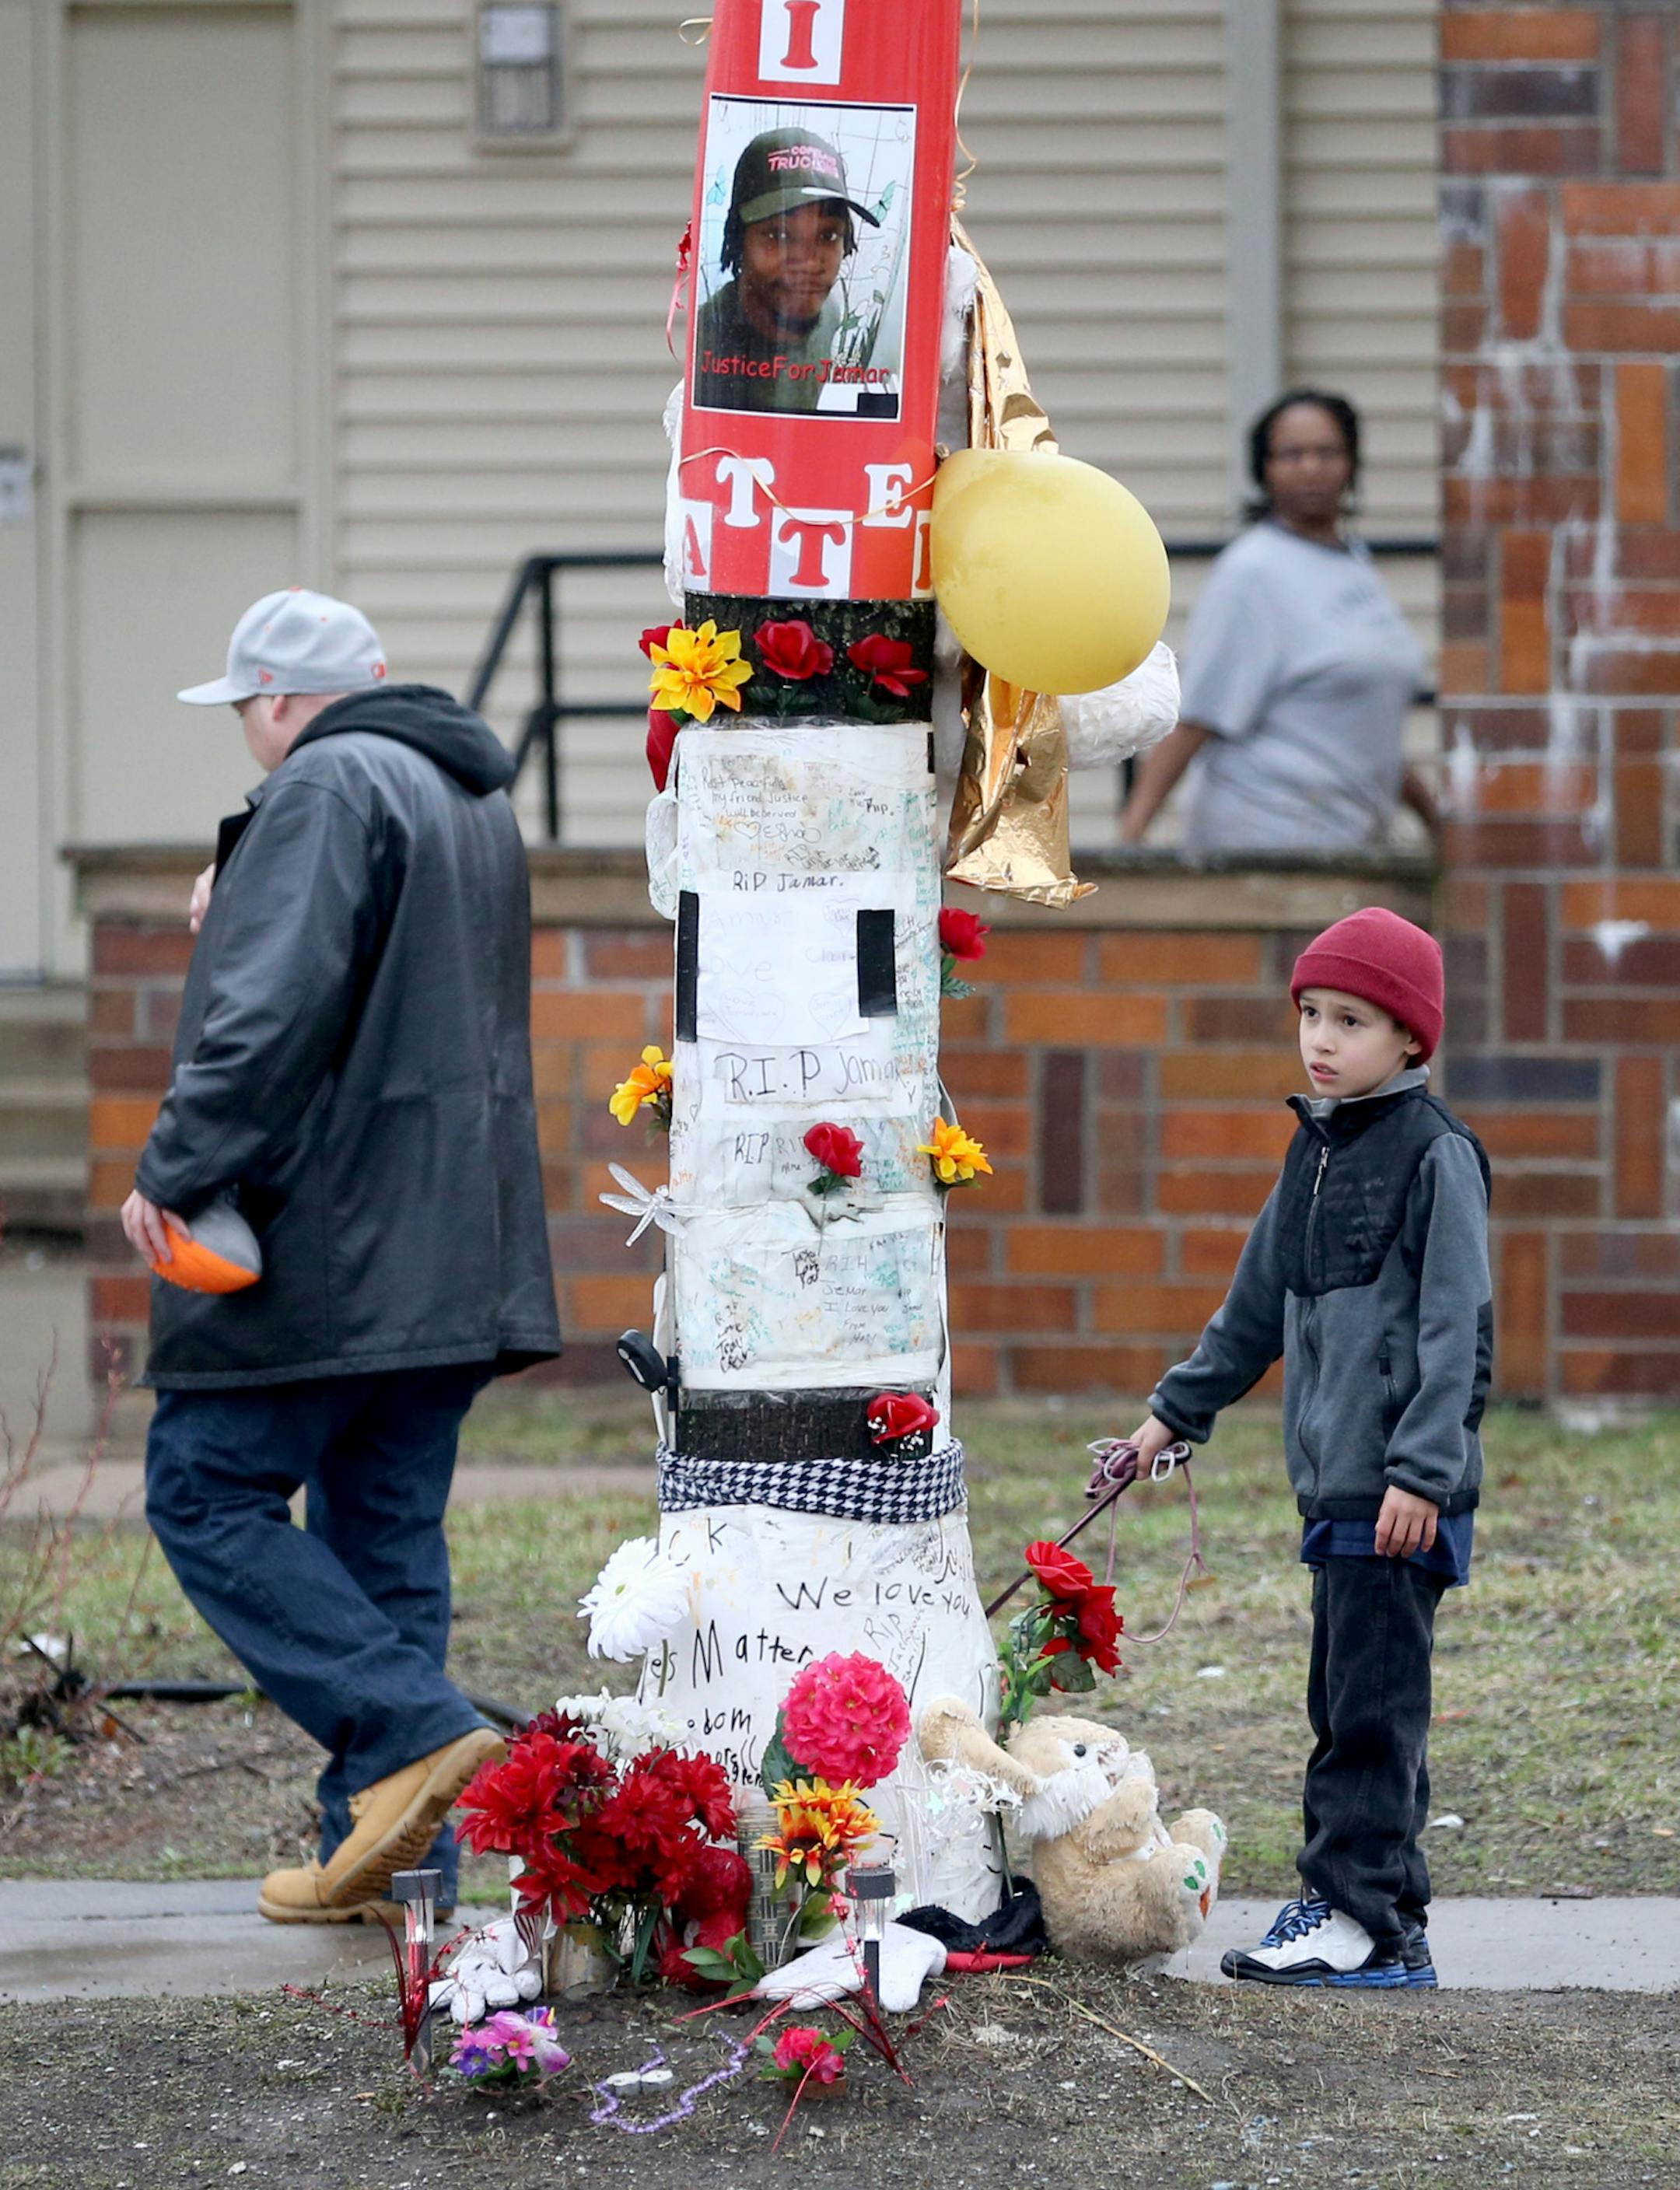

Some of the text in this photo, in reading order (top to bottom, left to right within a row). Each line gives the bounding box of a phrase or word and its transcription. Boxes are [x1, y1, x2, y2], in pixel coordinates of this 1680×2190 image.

[779, 0, 821, 69] I
[768, 155, 839, 179] TRUC
[777, 1576, 853, 1611] We
